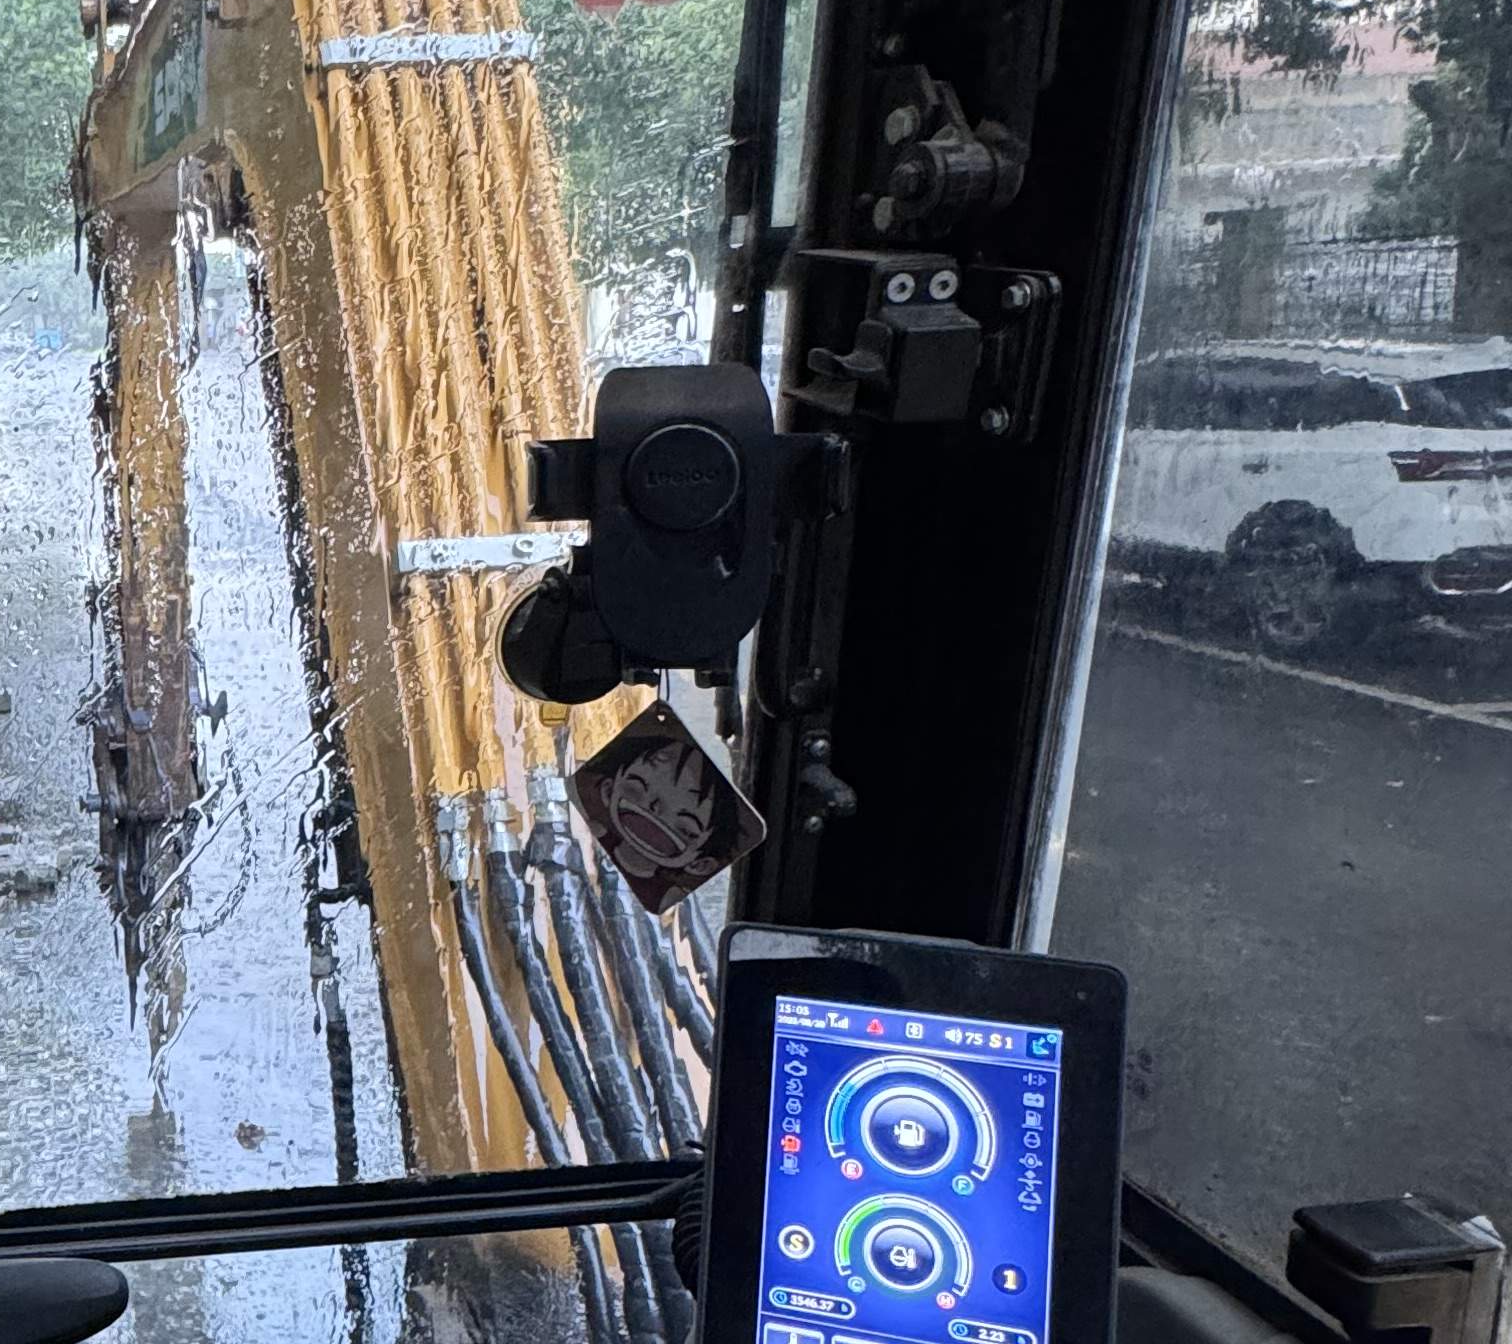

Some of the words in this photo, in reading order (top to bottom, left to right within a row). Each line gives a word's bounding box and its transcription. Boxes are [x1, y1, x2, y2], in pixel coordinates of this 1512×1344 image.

[965, 1031, 984, 1046] 75
[988, 1033, 1003, 1049] S
[1004, 1036, 1013, 1050] 1
[788, 1235, 804, 1252] S
[1002, 1269, 1018, 1290] 1
